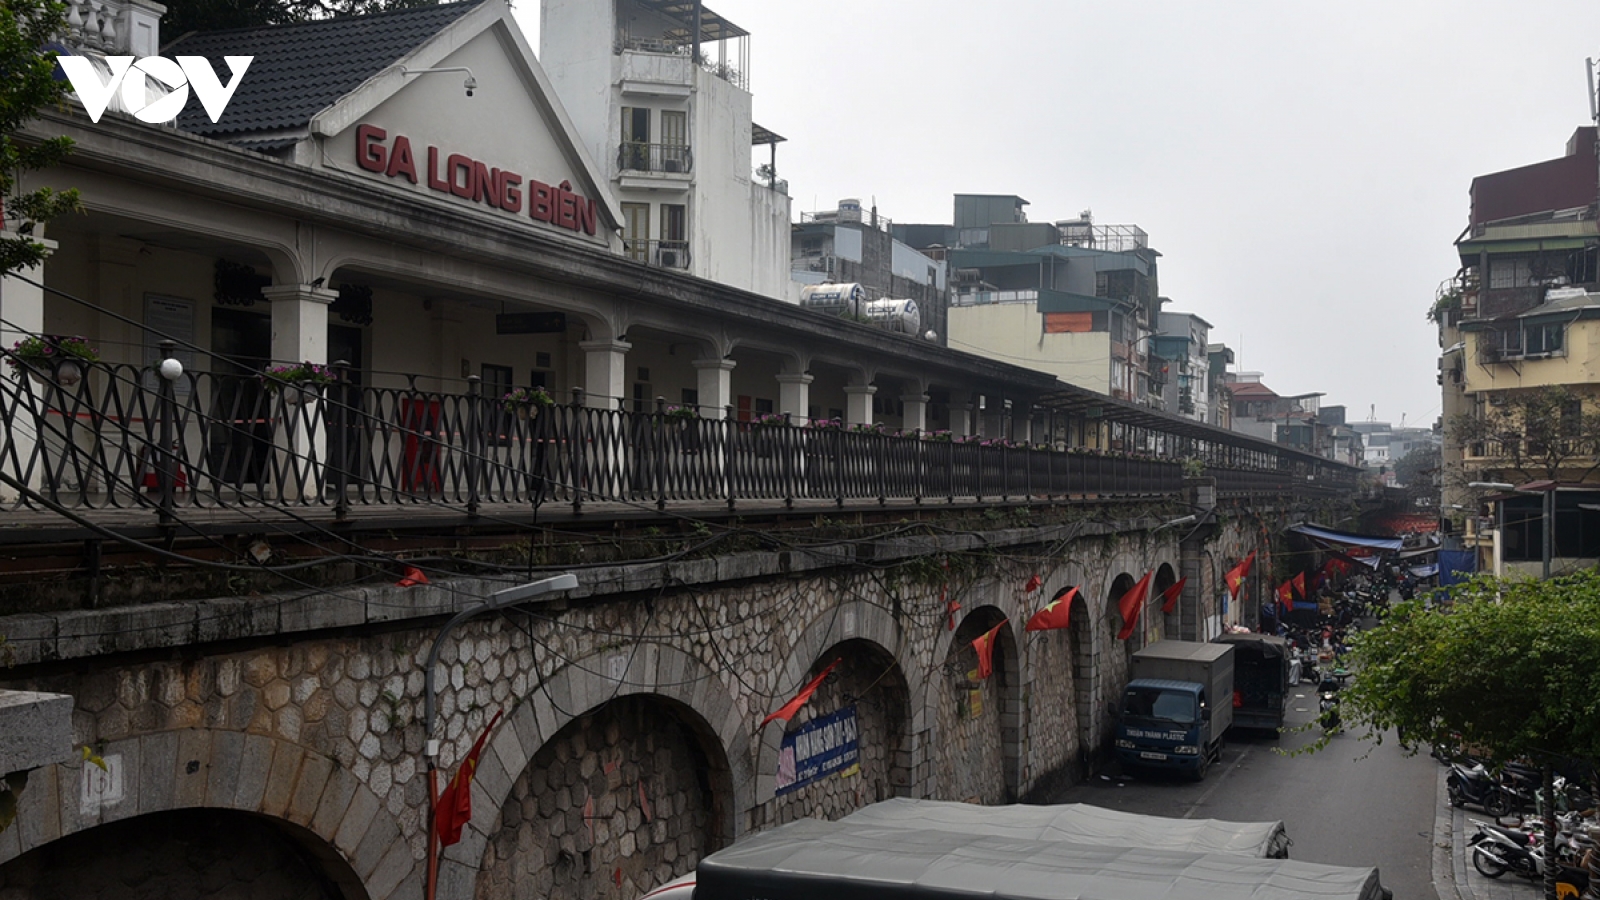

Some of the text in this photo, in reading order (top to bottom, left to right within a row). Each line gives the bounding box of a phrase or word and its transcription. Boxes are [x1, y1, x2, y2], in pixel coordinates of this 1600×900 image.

[356, 123, 597, 236] GA LONG BIÊN
[1162, 732, 1185, 741] PLASTIC
